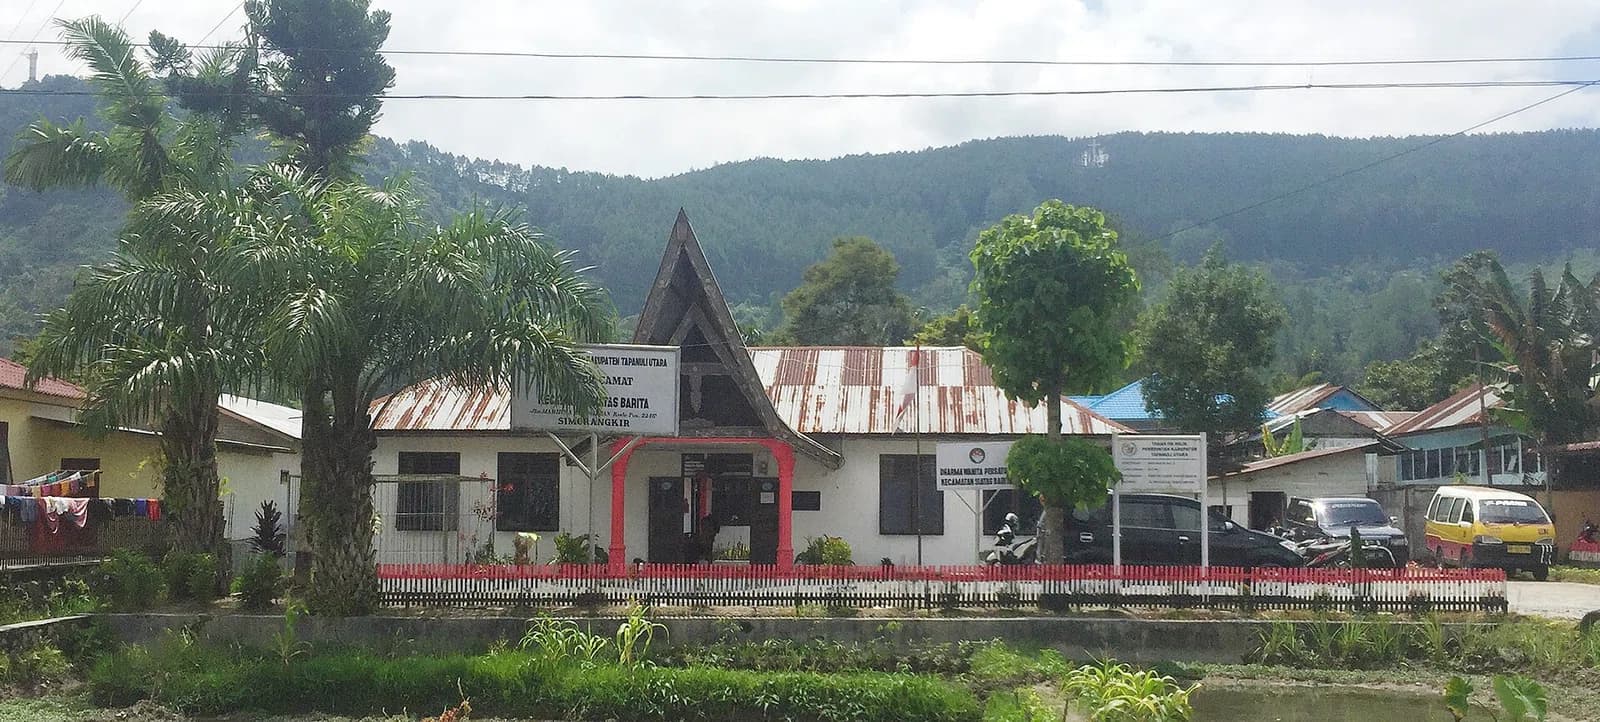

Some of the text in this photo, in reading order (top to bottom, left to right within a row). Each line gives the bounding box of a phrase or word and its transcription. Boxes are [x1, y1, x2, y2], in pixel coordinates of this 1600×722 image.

[621, 356, 648, 367] TAPANULI
[649, 357, 667, 367] UTARA
[620, 397, 649, 409] BARITA
[558, 417, 630, 427] SIMORANGKIR
[984, 467, 1008, 475] PERSATU
[941, 478, 974, 486] KECAMATAN
